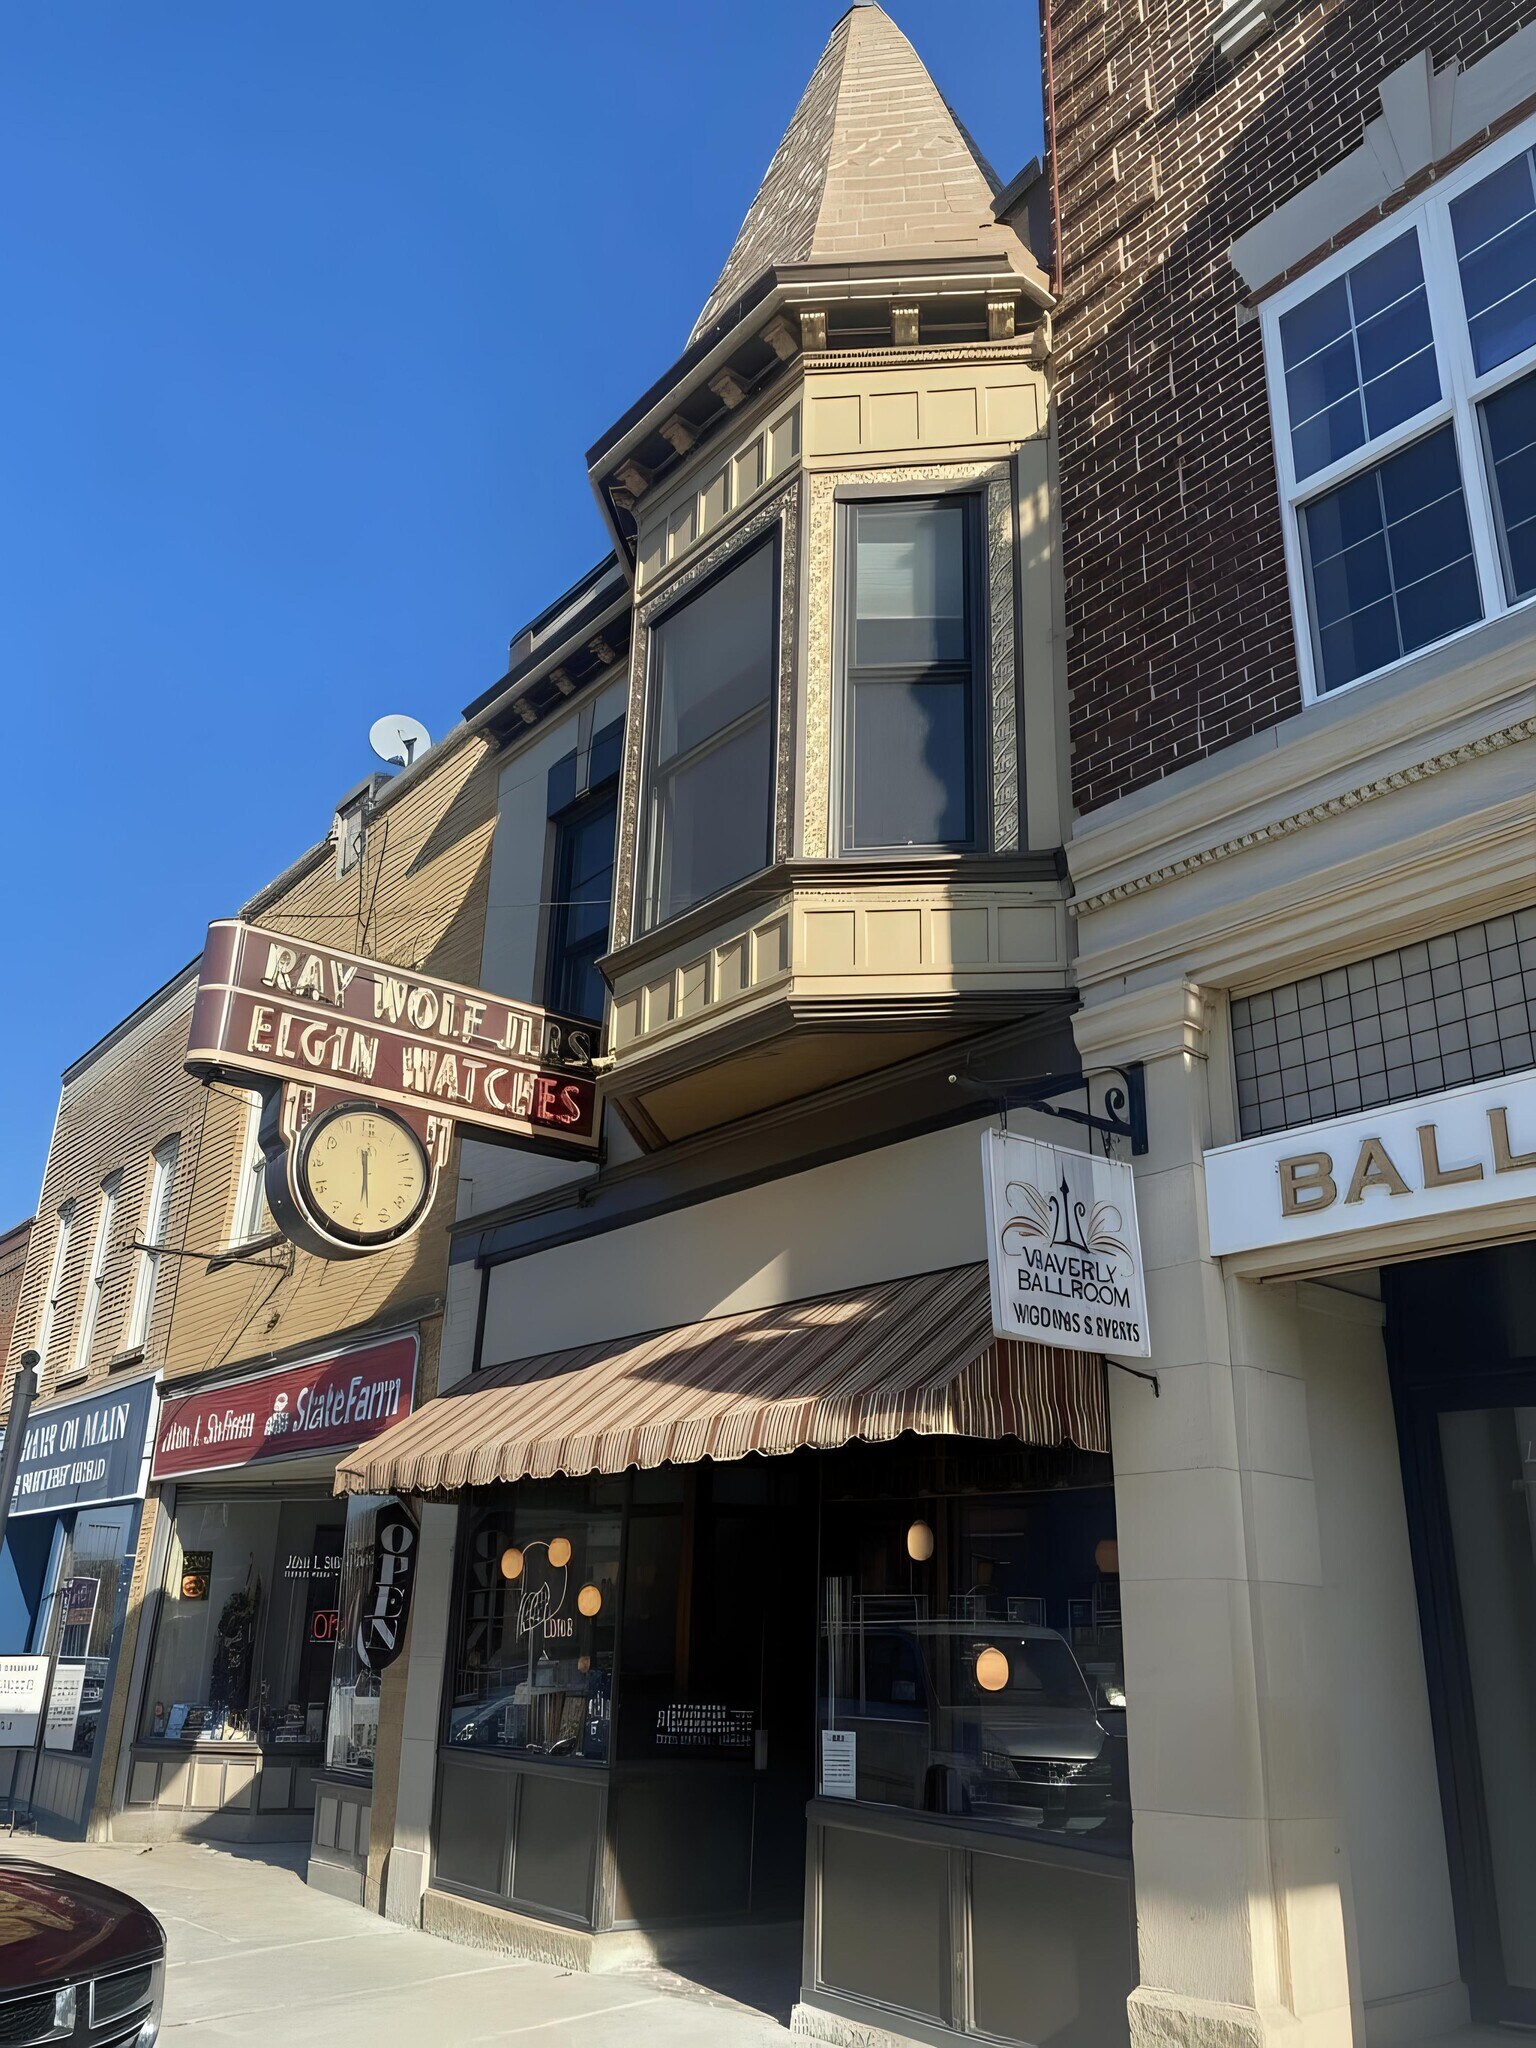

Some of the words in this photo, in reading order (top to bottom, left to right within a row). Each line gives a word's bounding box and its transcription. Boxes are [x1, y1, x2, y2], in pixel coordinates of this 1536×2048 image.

[262, 942, 358, 1008] RAY
[248, 1005, 379, 1079] ELGIN
[402, 1047, 581, 1124] WATCHES
[1018, 1268, 1130, 1308] BALLROOM
[1022, 1246, 1116, 1283] WAVERLY
